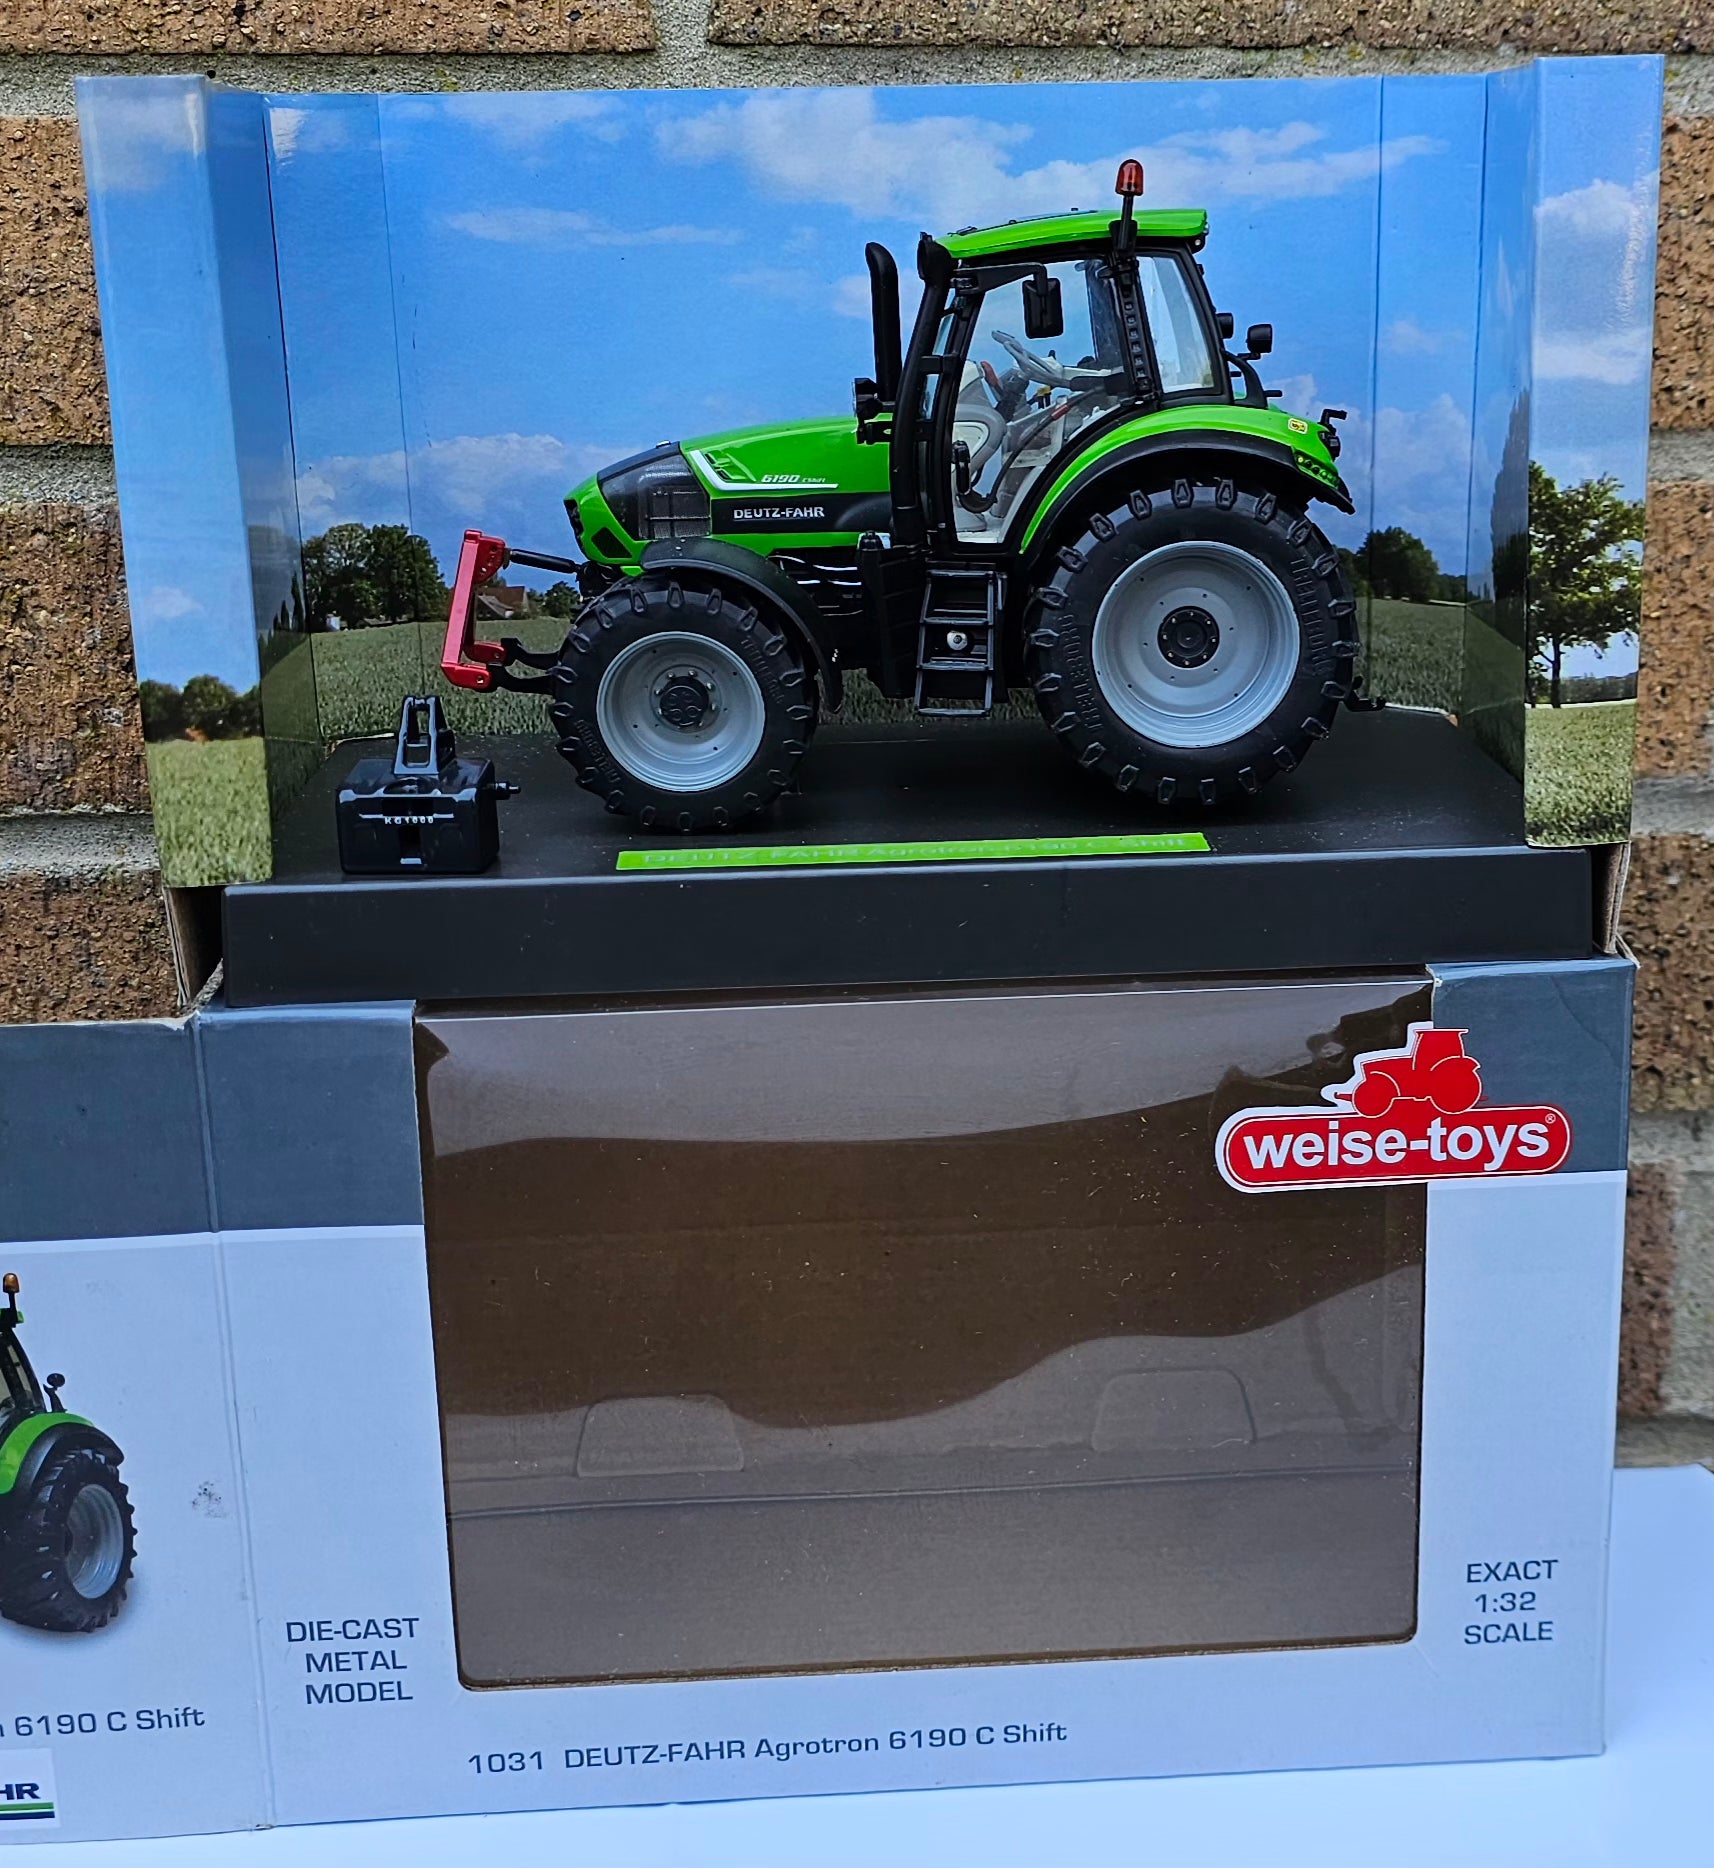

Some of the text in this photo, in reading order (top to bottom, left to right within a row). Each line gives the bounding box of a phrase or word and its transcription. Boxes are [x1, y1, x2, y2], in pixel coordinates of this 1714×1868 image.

[761, 474, 800, 483] 6190
[733, 506, 825, 519] DEUTZ-FAHR
[1243, 1116, 1549, 1171] weise-toys
[1466, 1559, 1559, 1583] EXACT
[1475, 1591, 1536, 1613] 1:32
[286, 1617, 420, 1643] DIE-CAST
[1464, 1621, 1554, 1645] SCALE
[305, 1649, 408, 1673] METAL
[305, 1680, 414, 1705] MODEL
[15, 1713, 97, 1737] 6190
[107, 1711, 128, 1732] C
[136, 1706, 206, 1731] Shift
[468, 1722, 1068, 1774] 1031 DEUTZ-FAHR Agrotron 6190 C Shift
